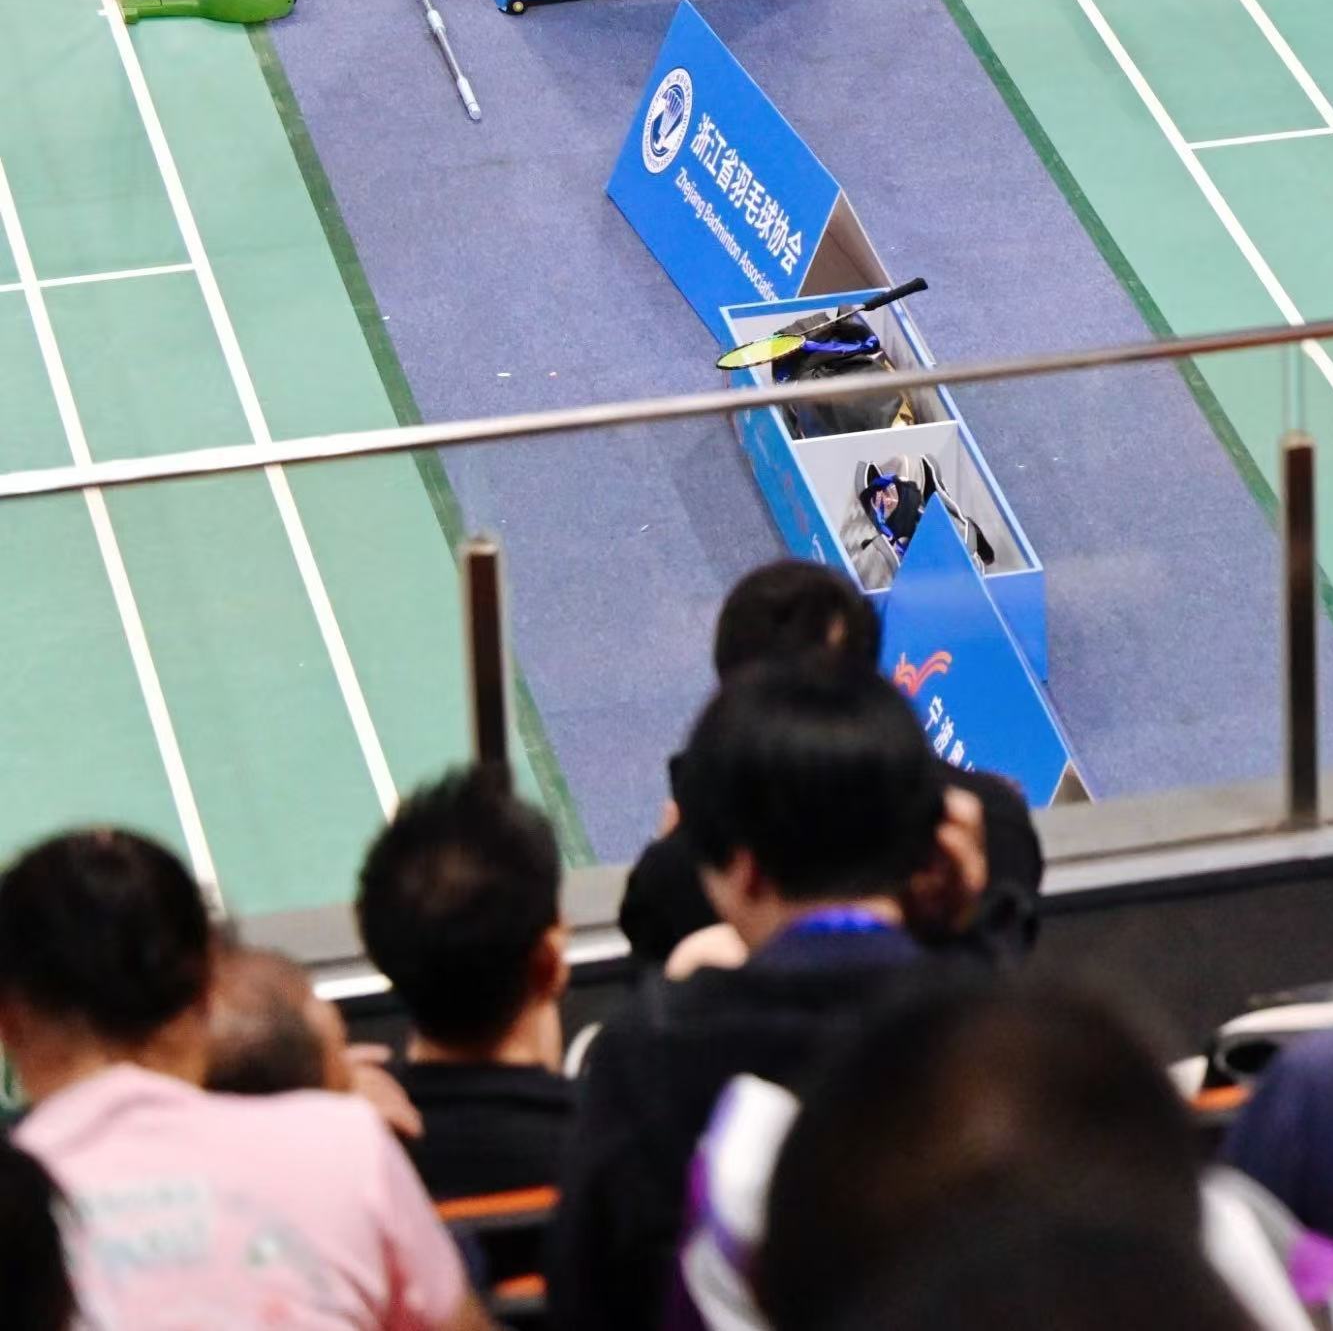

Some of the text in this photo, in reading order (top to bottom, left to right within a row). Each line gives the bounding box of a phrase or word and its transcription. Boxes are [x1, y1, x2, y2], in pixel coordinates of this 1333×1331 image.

[675, 166, 704, 219] Zhejiang
[702, 202, 742, 260] Badminton
[690, 112, 803, 276] 浙江省羽毛球协会
